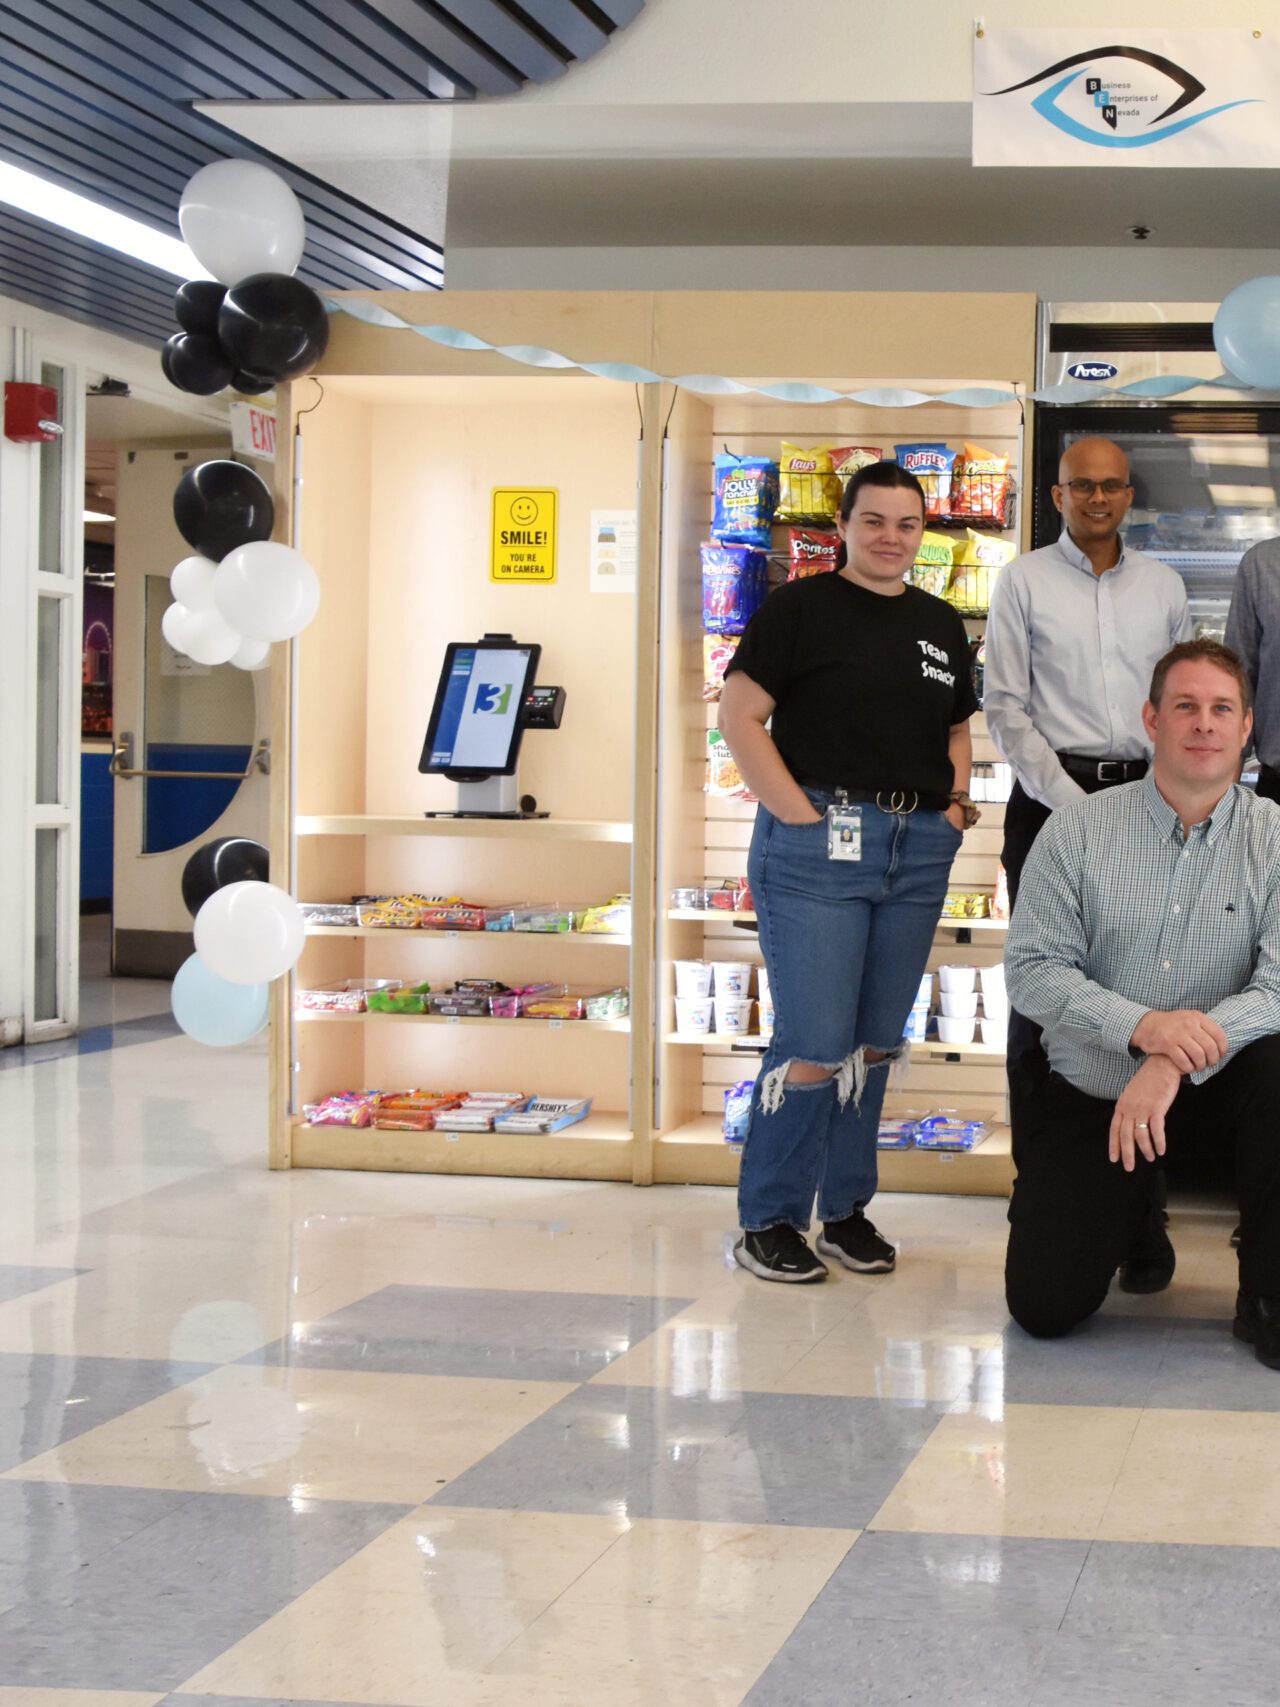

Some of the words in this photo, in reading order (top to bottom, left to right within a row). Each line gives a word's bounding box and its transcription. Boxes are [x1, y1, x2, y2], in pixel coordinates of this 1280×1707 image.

[1088, 80, 1131, 91] Business
[1097, 93, 1148, 104] Enterprises
[1150, 94, 1158, 102] of
[1105, 108, 1140, 119] Nevada
[905, 453, 942, 468] RUFFLES
[724, 479, 756, 492] JOLLY
[501, 531, 547, 545] SMILE!
[794, 540, 835, 554] Doritos
[502, 565, 511, 573] ON
[514, 565, 545, 573] CAMERA
[917, 640, 949, 665] Team
[921, 661, 956, 688] Snack
